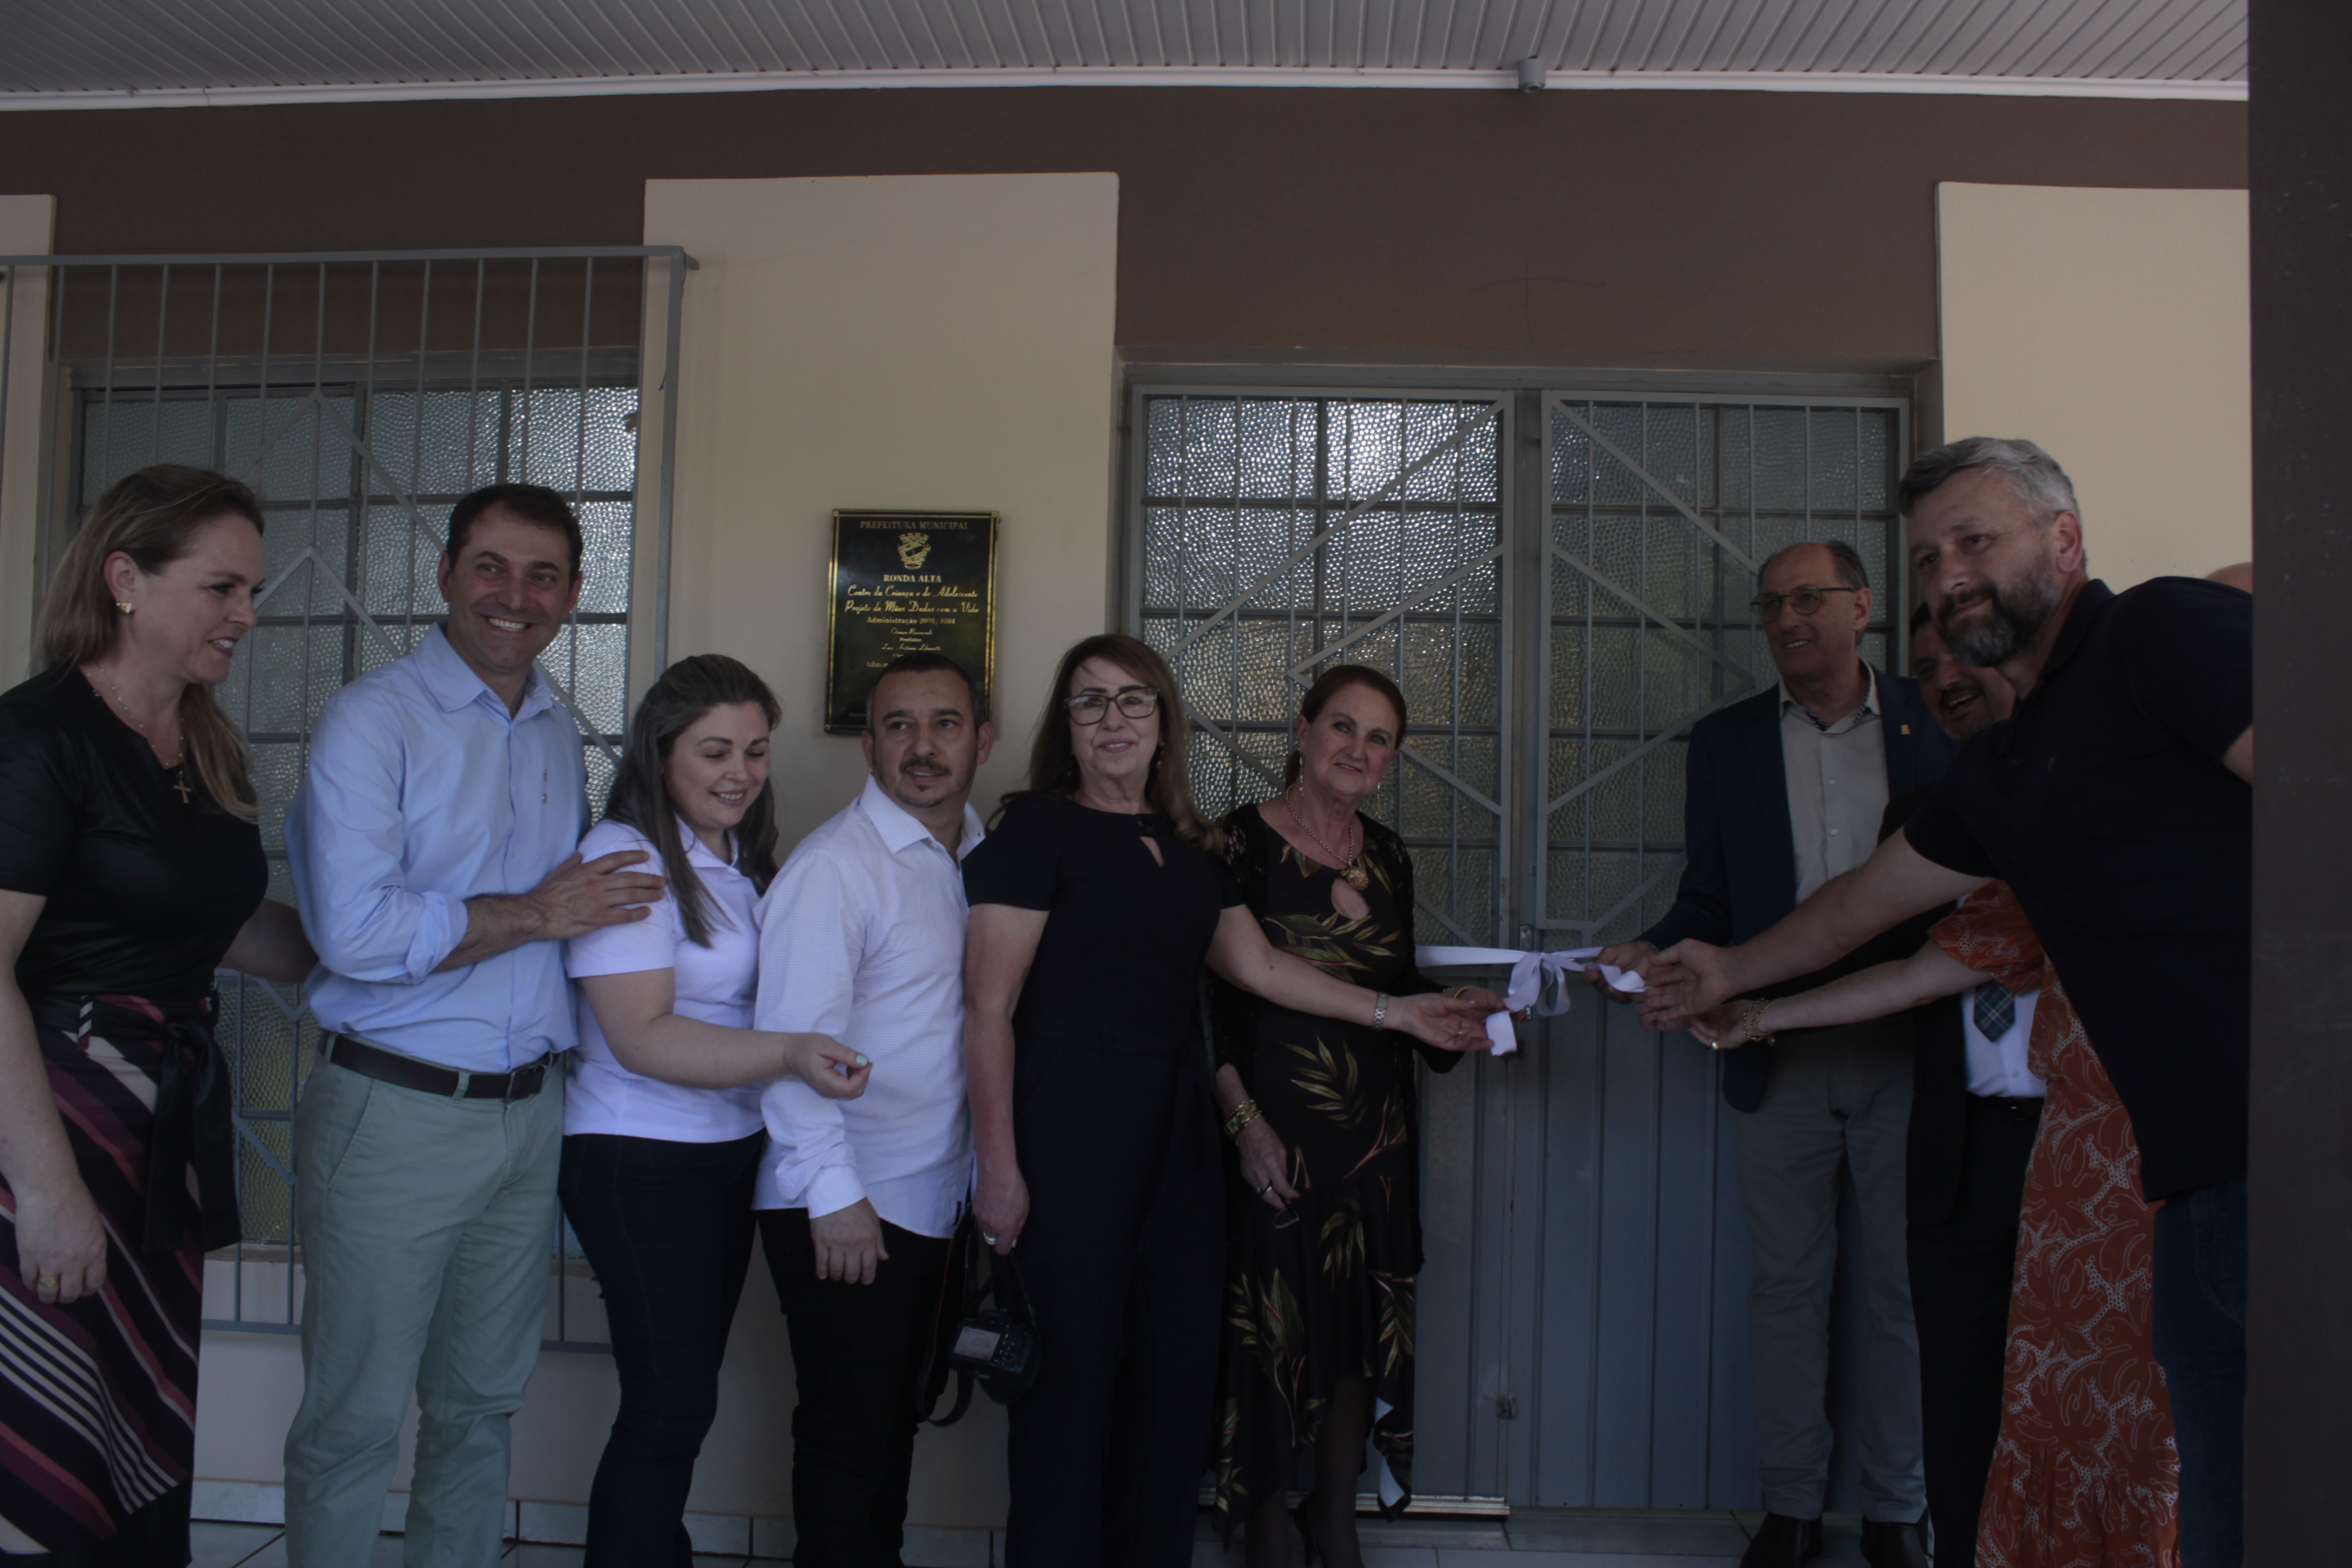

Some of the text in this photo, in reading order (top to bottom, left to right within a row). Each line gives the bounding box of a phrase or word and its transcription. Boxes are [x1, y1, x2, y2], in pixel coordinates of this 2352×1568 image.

[860, 521, 969, 530] PREFEITURA MUNICIPAL
[847, 584, 871, 596] Centro
[885, 585, 914, 598] Criança
[932, 586, 978, 597] Adolescente
[844, 600, 871, 614] Projeto
[884, 600, 905, 613] Mãos
[907, 600, 934, 612] Dadas
[961, 601, 979, 613] Vida
[867, 617, 918, 625] Administração
